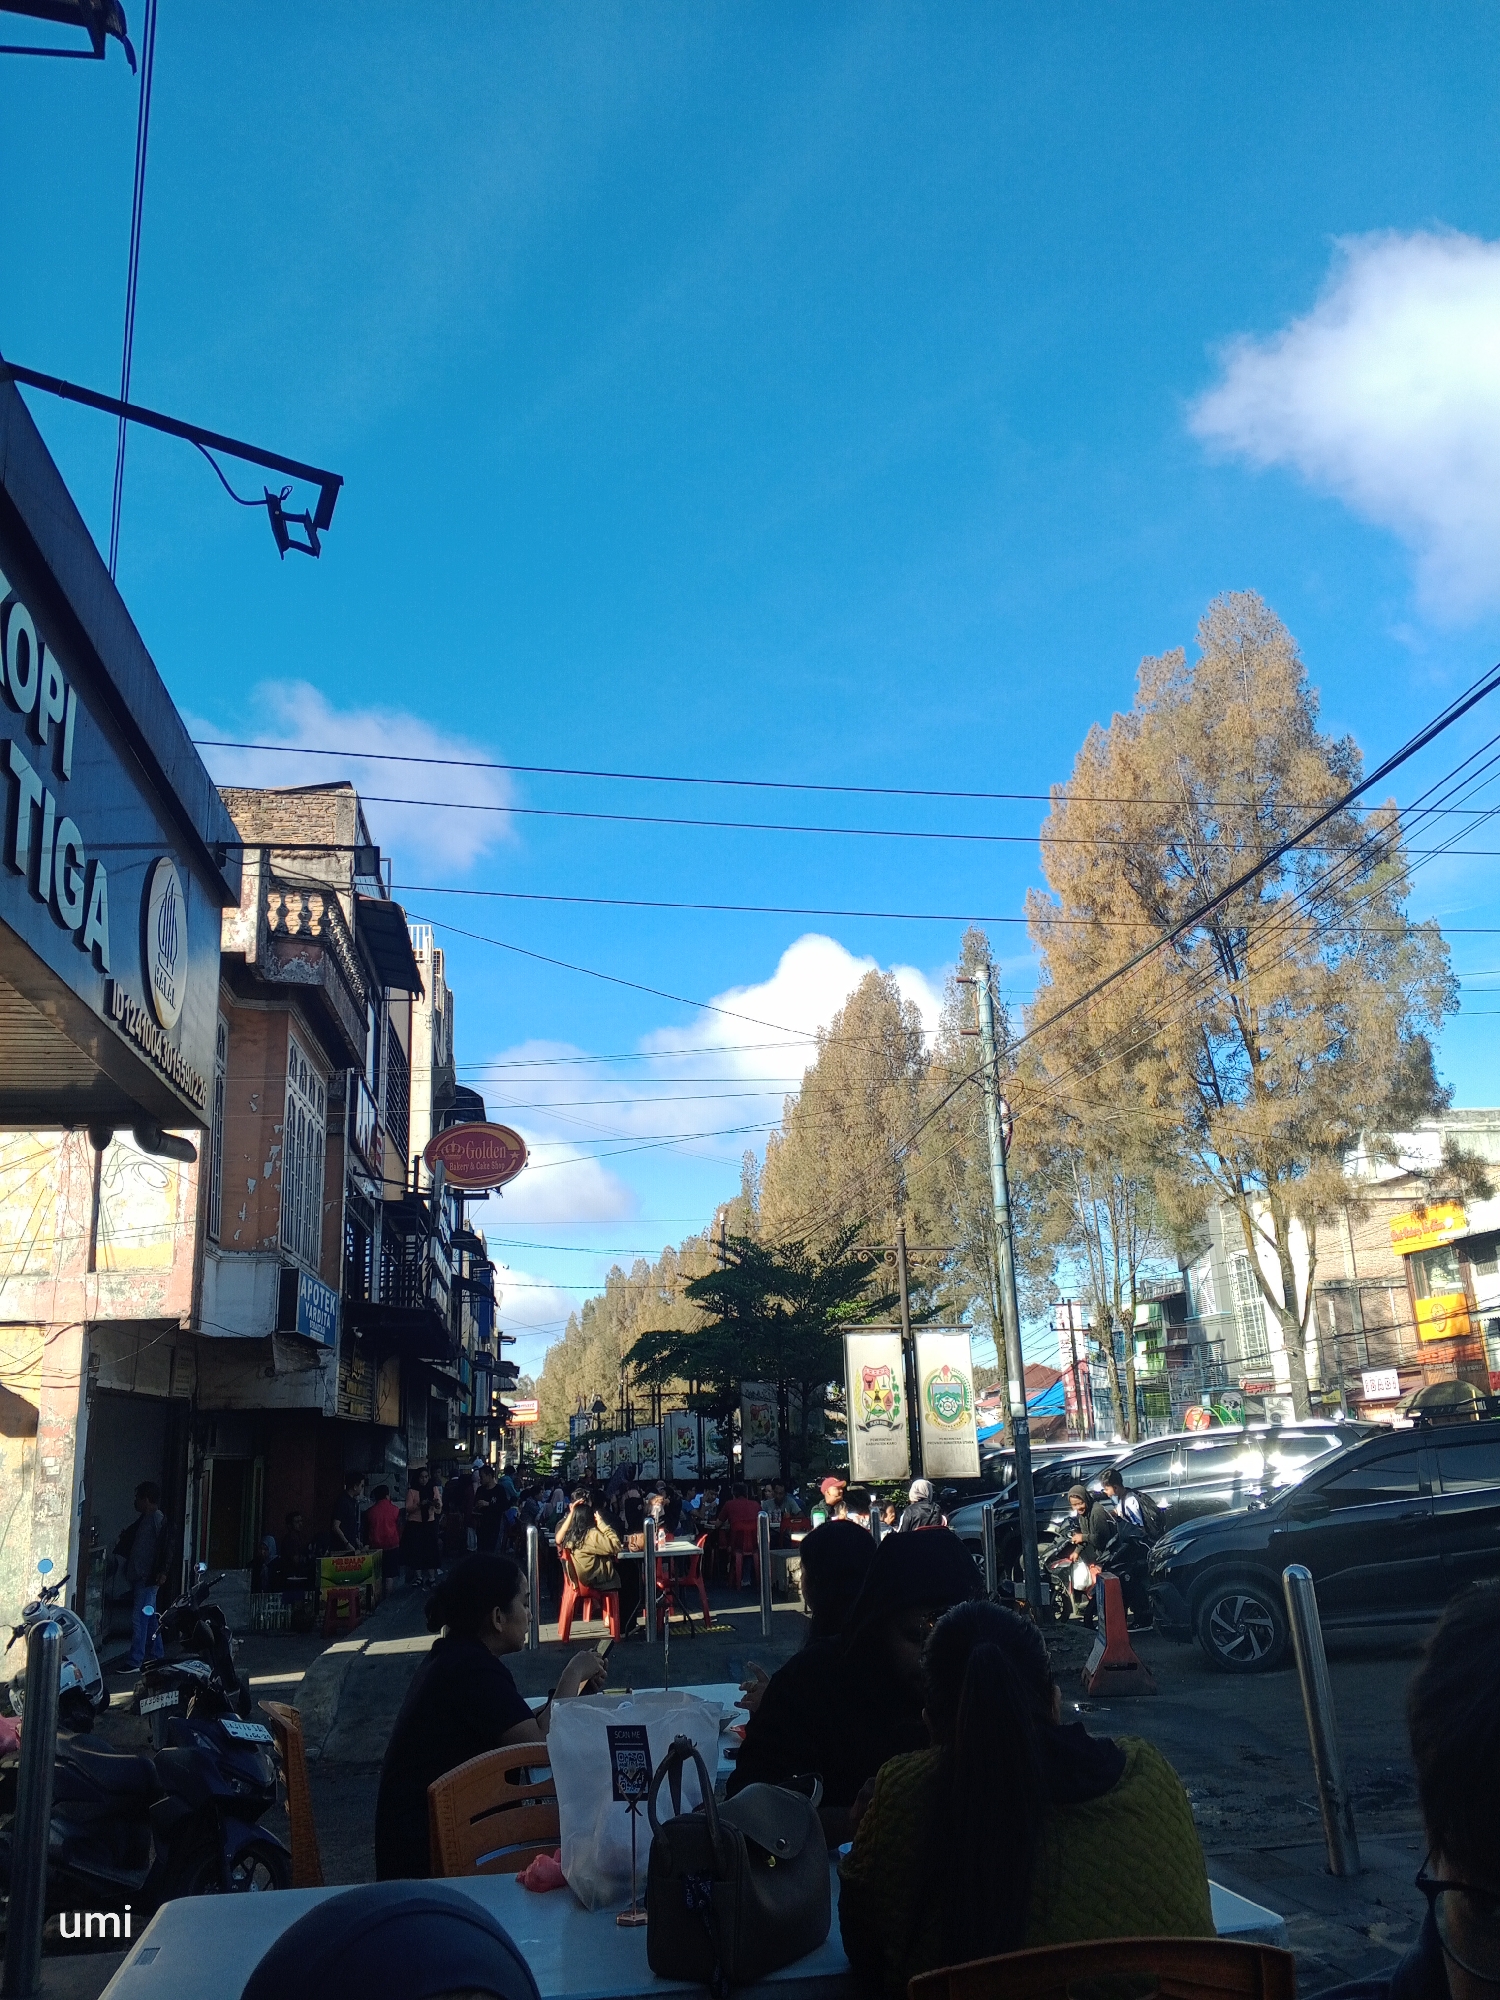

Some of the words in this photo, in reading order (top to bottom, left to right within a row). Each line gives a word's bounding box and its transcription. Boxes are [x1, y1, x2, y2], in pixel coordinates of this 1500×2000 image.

[0, 568, 77, 782] OPI
[9, 739, 111, 974] TIGA
[154, 963, 176, 1010] HALAL
[449, 1161, 469, 1173] Bakery
[470, 1161, 475, 1169] &
[476, 1161, 490, 1171] Cake
[491, 1160, 506, 1172] Shop
[465, 1140, 507, 1160] Golden
[300, 1275, 336, 1316] APOTEK
[305, 1301, 331, 1329] YARDITA
[614, 1730, 631, 1739] SCAN
[631, 1730, 641, 1739] ME
